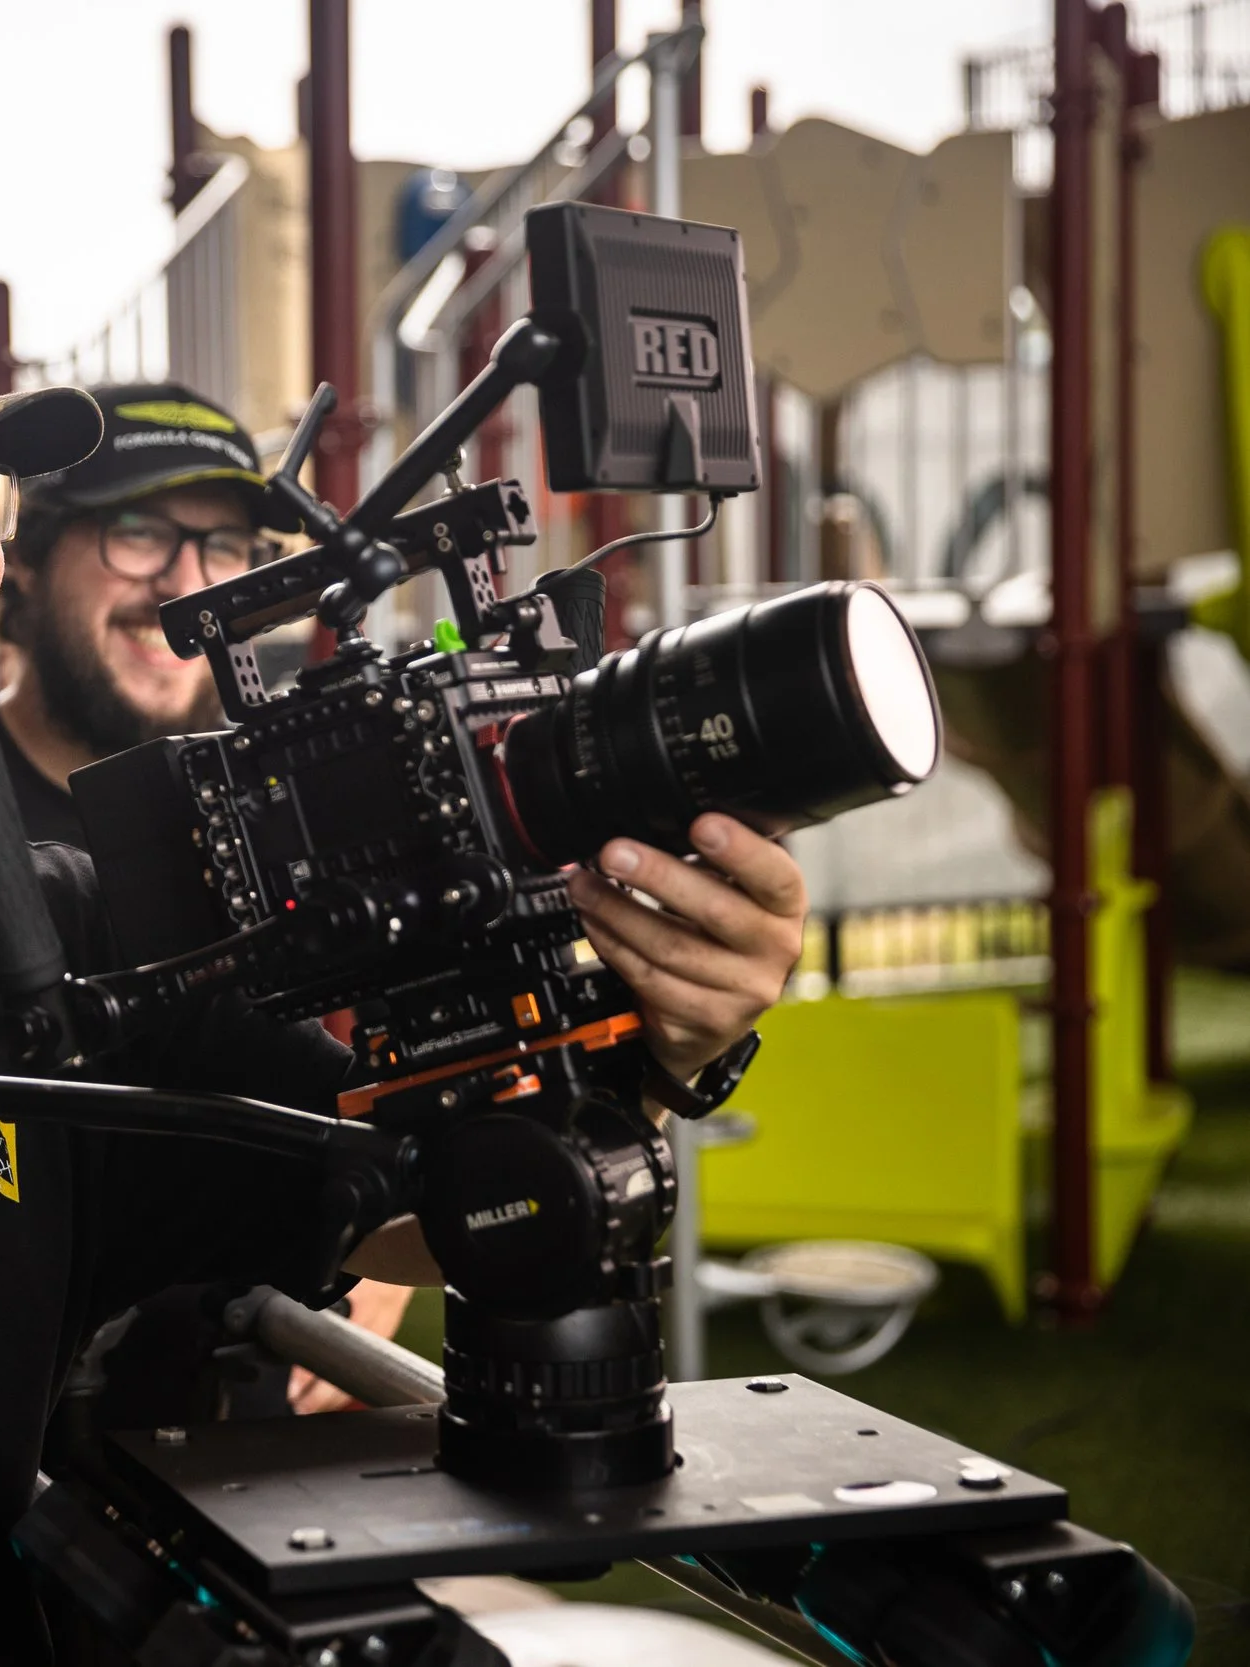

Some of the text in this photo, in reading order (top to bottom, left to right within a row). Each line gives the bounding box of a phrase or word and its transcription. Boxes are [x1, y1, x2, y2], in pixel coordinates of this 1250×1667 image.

[633, 321, 719, 378] RED
[700, 713, 734, 742] 40
[465, 1200, 530, 1230] MILLER
